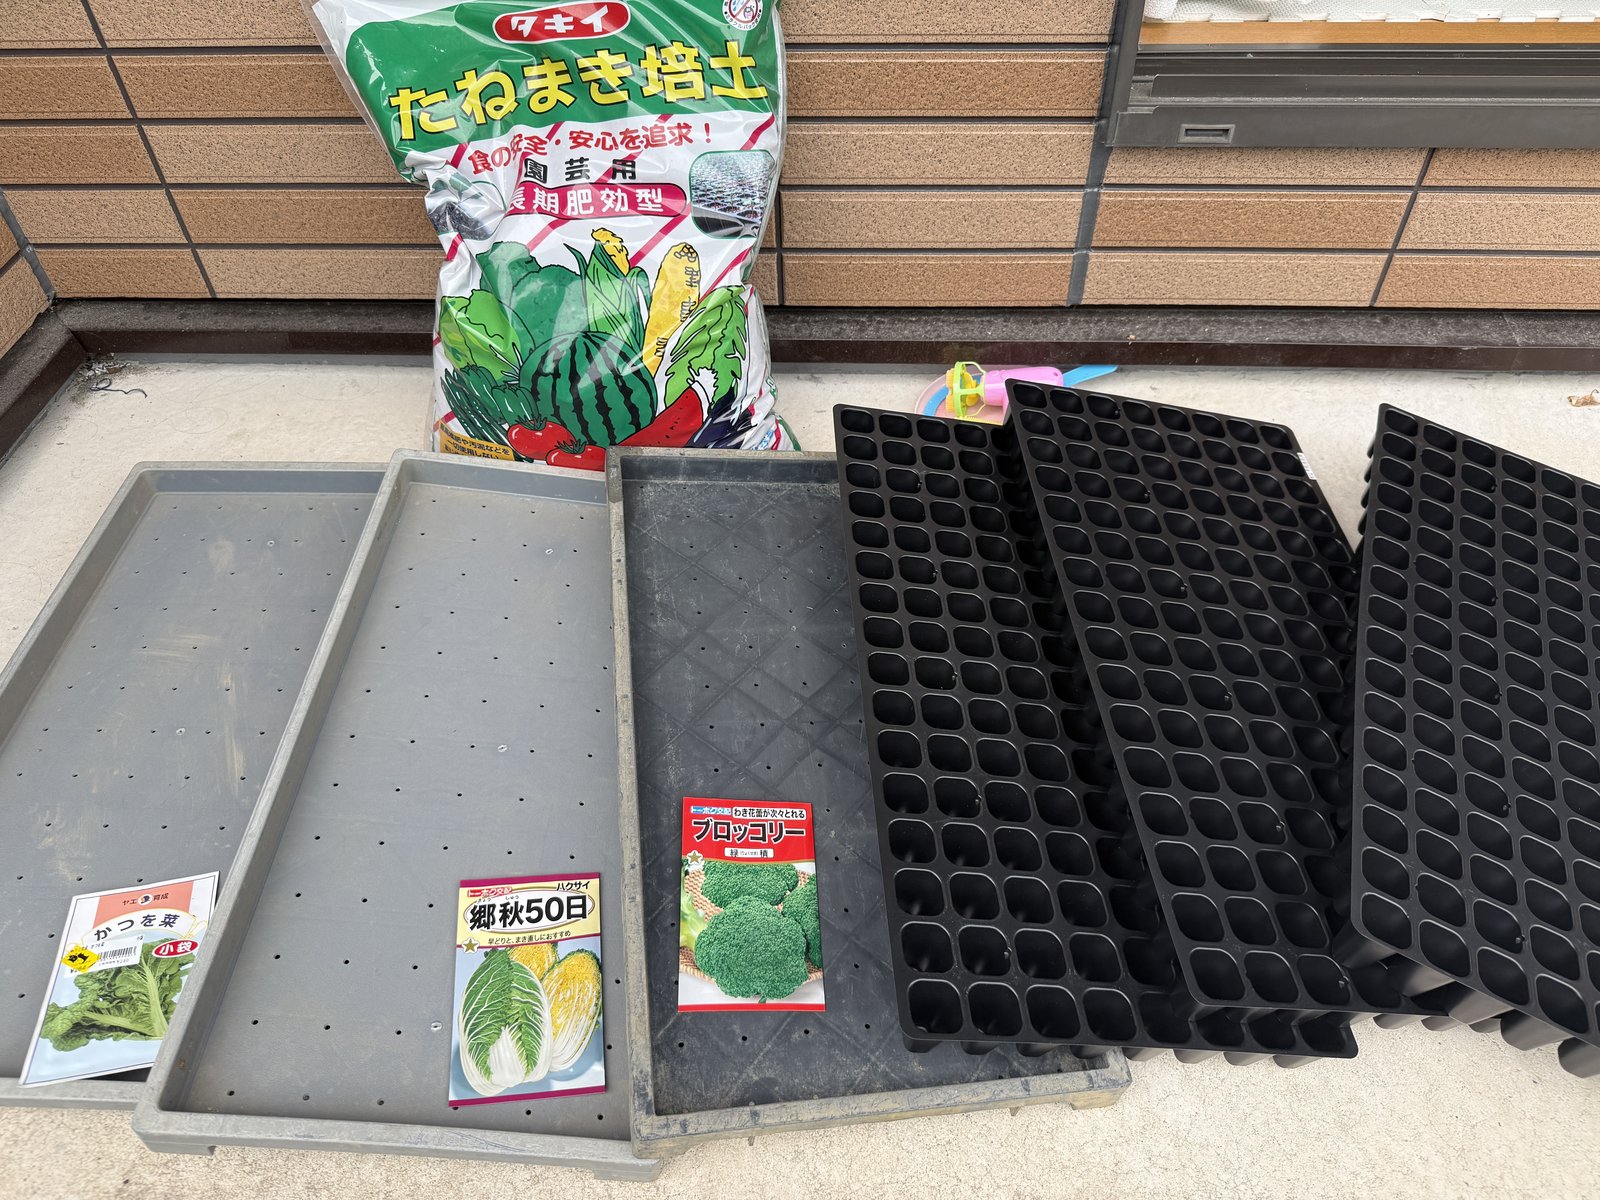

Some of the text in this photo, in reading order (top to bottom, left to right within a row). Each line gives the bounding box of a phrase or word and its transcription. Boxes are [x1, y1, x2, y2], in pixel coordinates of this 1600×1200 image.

[510, 4, 606, 33] タキイ
[388, 40, 768, 141] たねまき培土
[523, 156, 637, 184] 園芸用
[734, 807, 806, 819] わき花蕾が次々とれる
[692, 818, 805, 844] ブロッコリー
[556, 881, 591, 891] ハクサイ
[469, 895, 587, 931] 郷秋50日
[93, 914, 180, 941] かつを菜
[158, 940, 194, 956] 小袋
